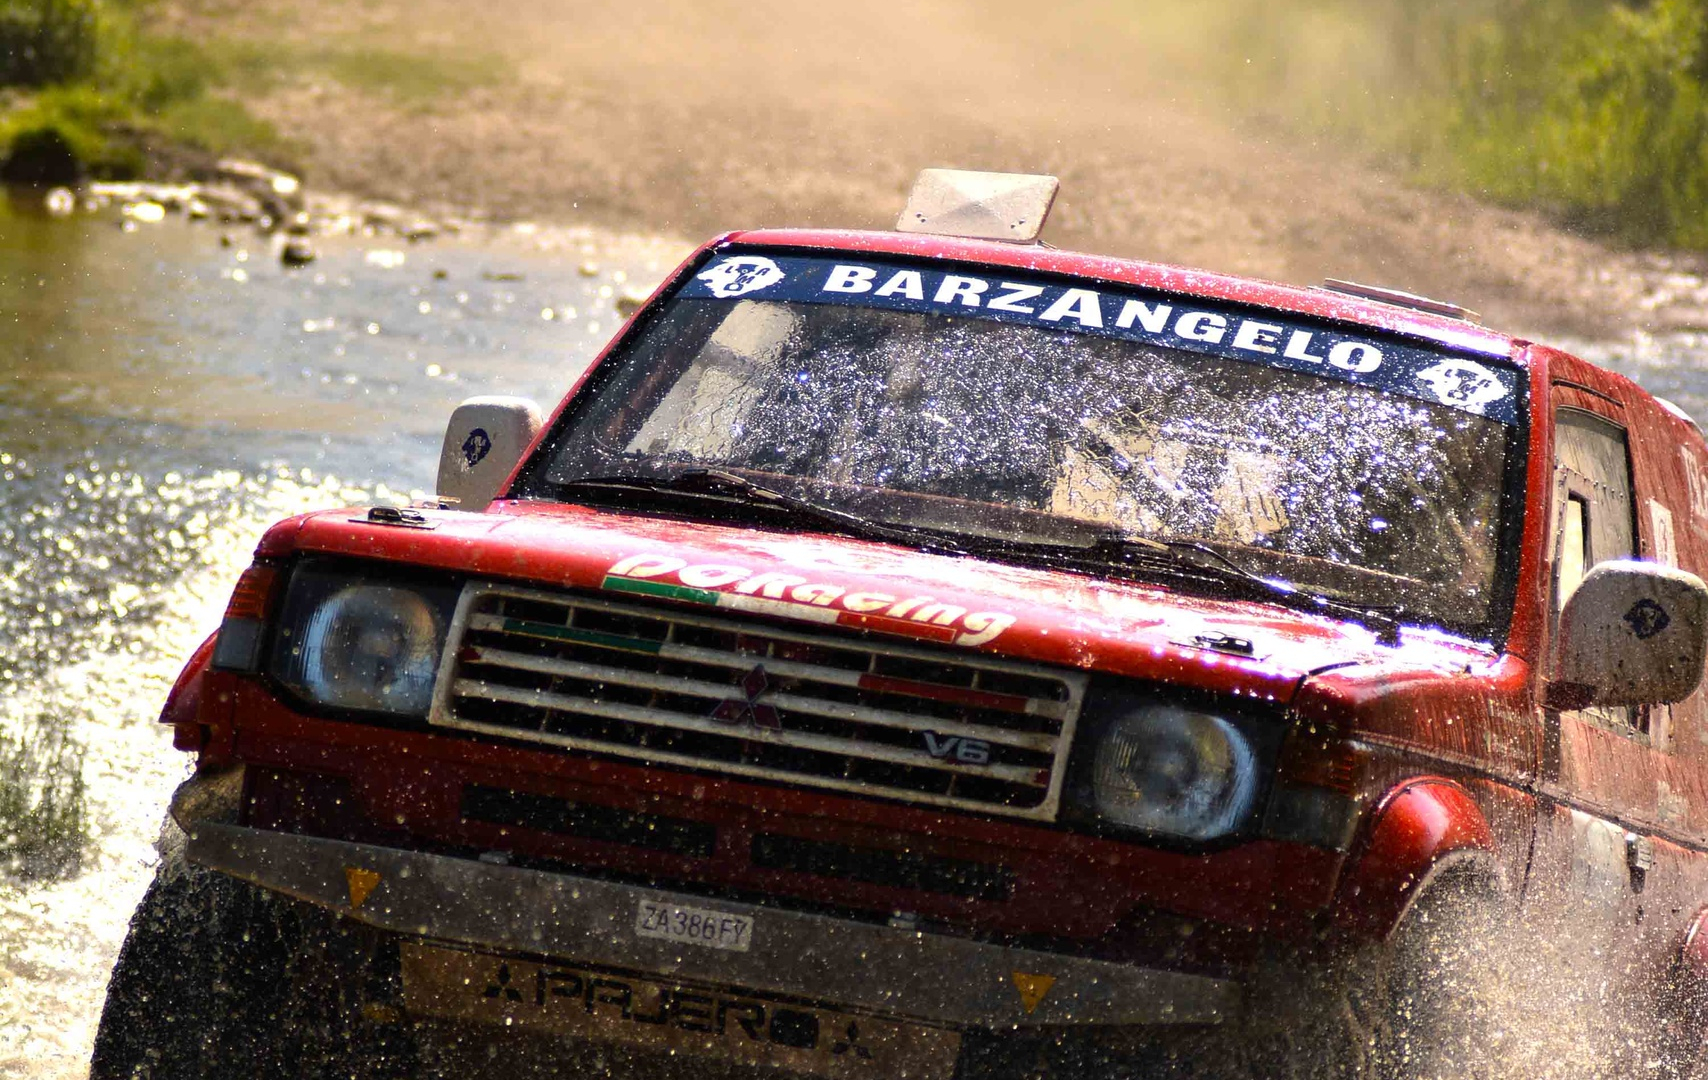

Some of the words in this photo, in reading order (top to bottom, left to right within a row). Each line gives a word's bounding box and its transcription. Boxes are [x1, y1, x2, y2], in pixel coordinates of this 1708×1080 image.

[823, 264, 1383, 373] BARZANGELO
[923, 732, 989, 764] V6
[642, 905, 747, 944] ZA386FY
[536, 968, 819, 1049] PAJERO
